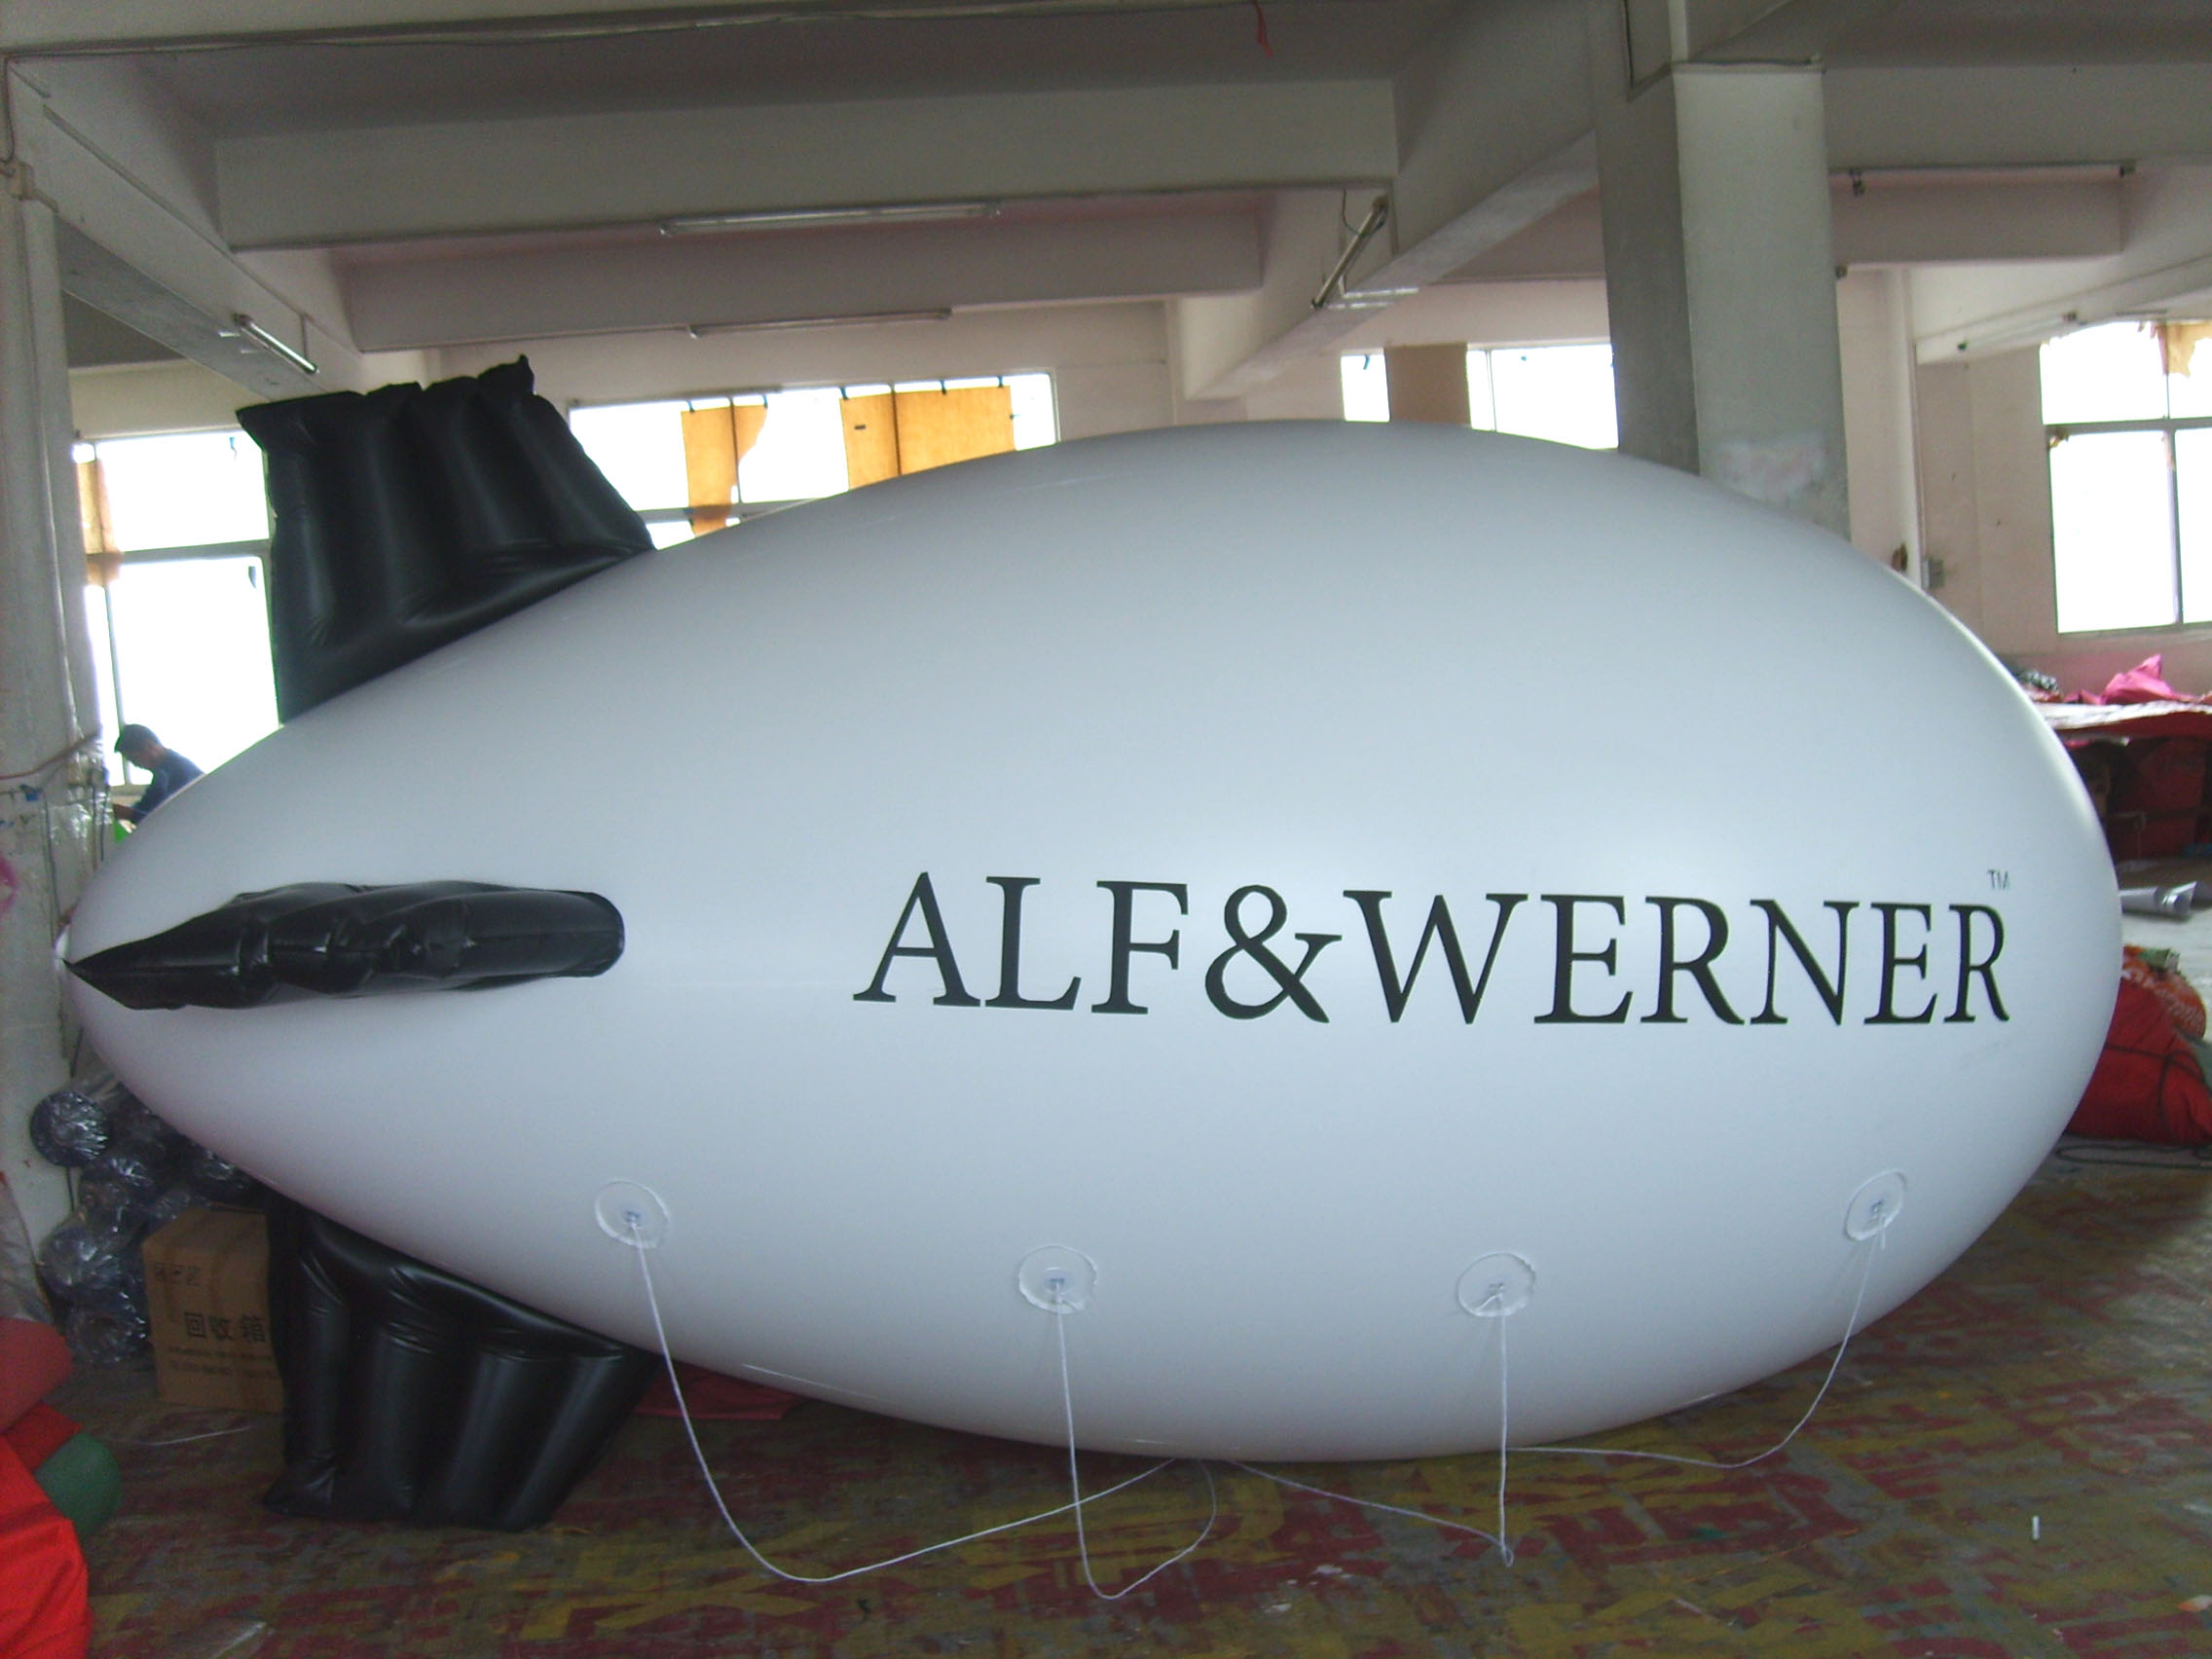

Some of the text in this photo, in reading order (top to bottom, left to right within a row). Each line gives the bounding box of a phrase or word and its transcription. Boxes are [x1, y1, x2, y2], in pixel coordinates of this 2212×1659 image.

[1987, 868, 2009, 889] TM
[853, 871, 2010, 1025] ALF&WERNER
[184, 1311, 266, 1343] 回收箱
